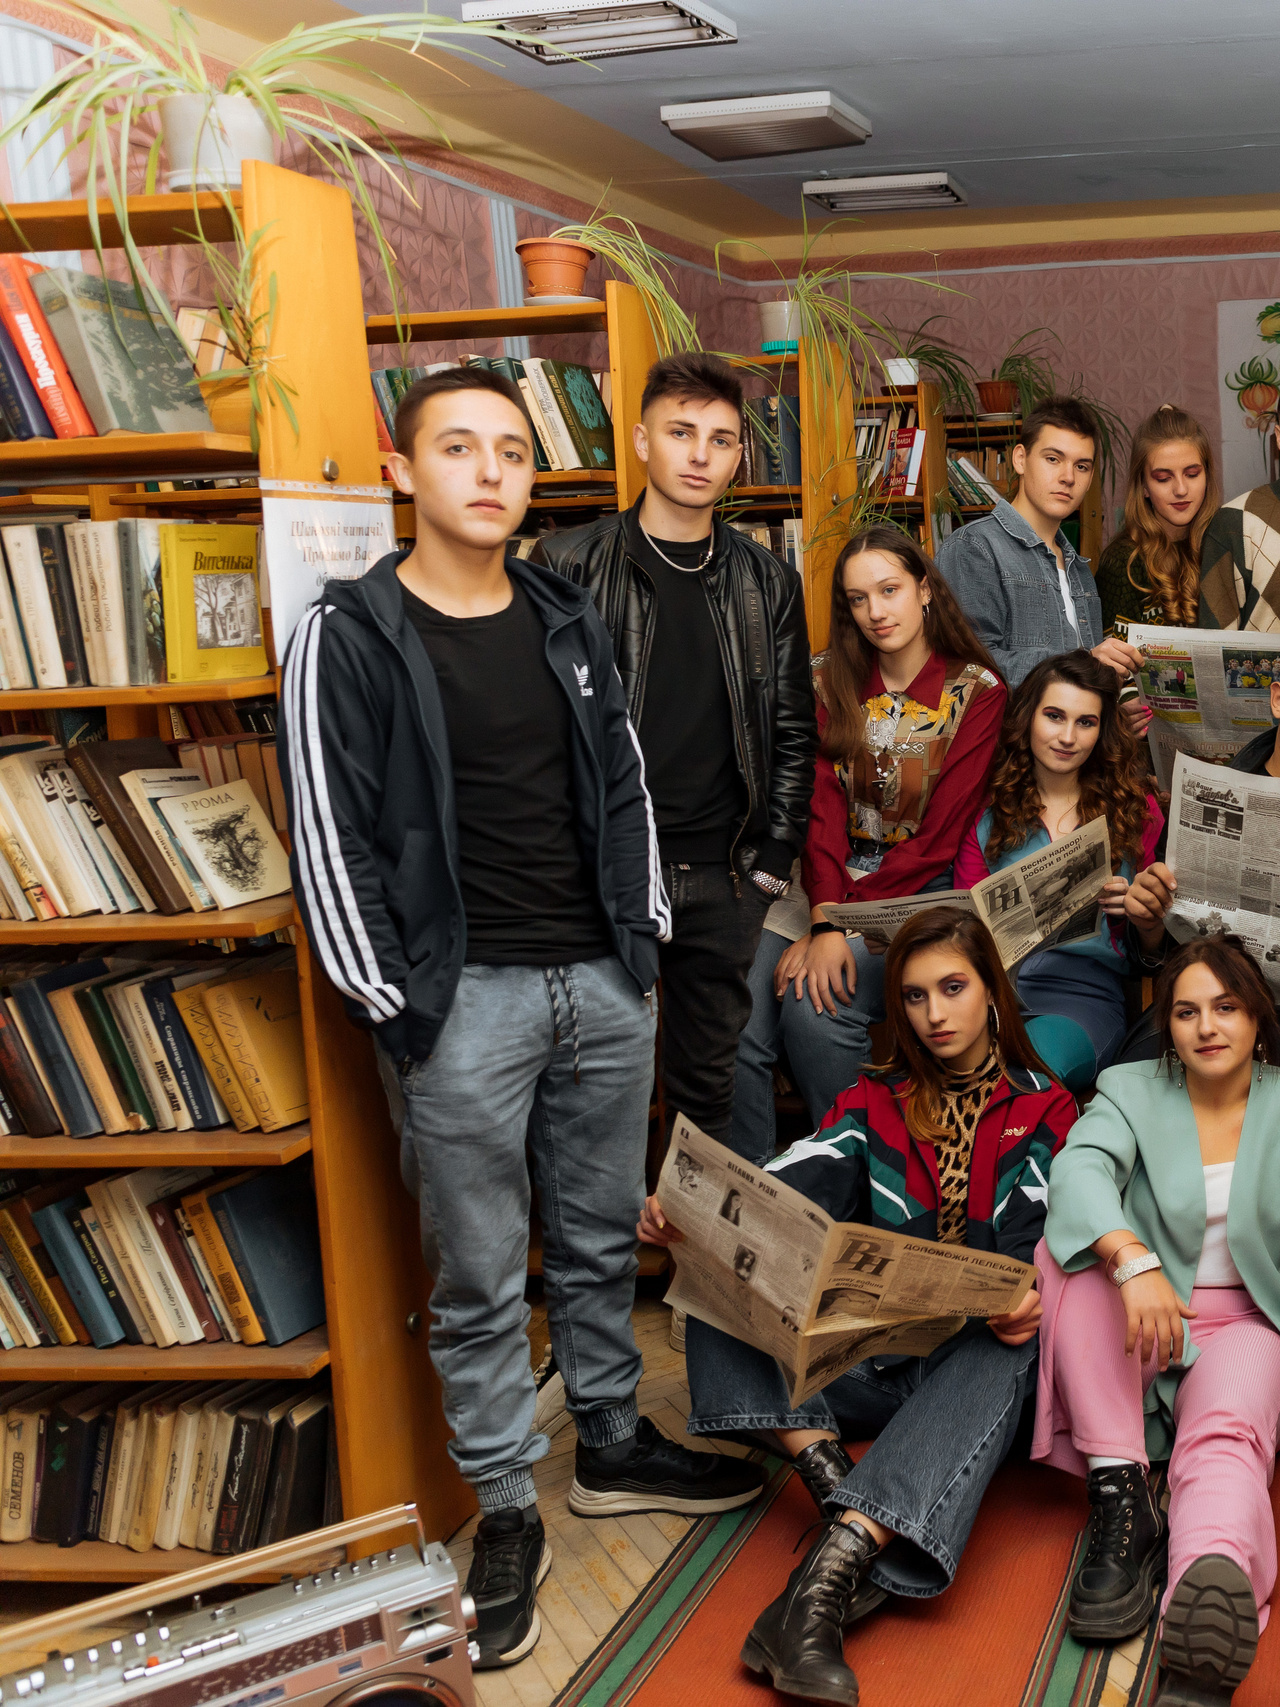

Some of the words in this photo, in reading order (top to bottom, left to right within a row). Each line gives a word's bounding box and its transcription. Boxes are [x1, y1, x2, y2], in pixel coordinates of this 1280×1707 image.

[15, 313, 58, 390] Проскурин
[92, 531, 108, 600] Рождественский
[193, 551, 254, 571] Витенька
[103, 603, 112, 632] Роберт
[1196, 781, 1213, 792] Ваше
[1020, 854, 1048, 874] Весна
[1049, 835, 1083, 861] надворі
[1023, 862, 1055, 881] роботи
[1064, 843, 1081, 860] полі
[165, 1025, 184, 1069] Страницы
[79, 1232, 100, 1265] Северов
[904, 1242, 969, 1263] ДОПОМОЖИ
[95, 1264, 110, 1285] Петр
[155, 1270, 177, 1308] Серебрякова
[5, 1451, 29, 1520] СЕМЕНОВ
